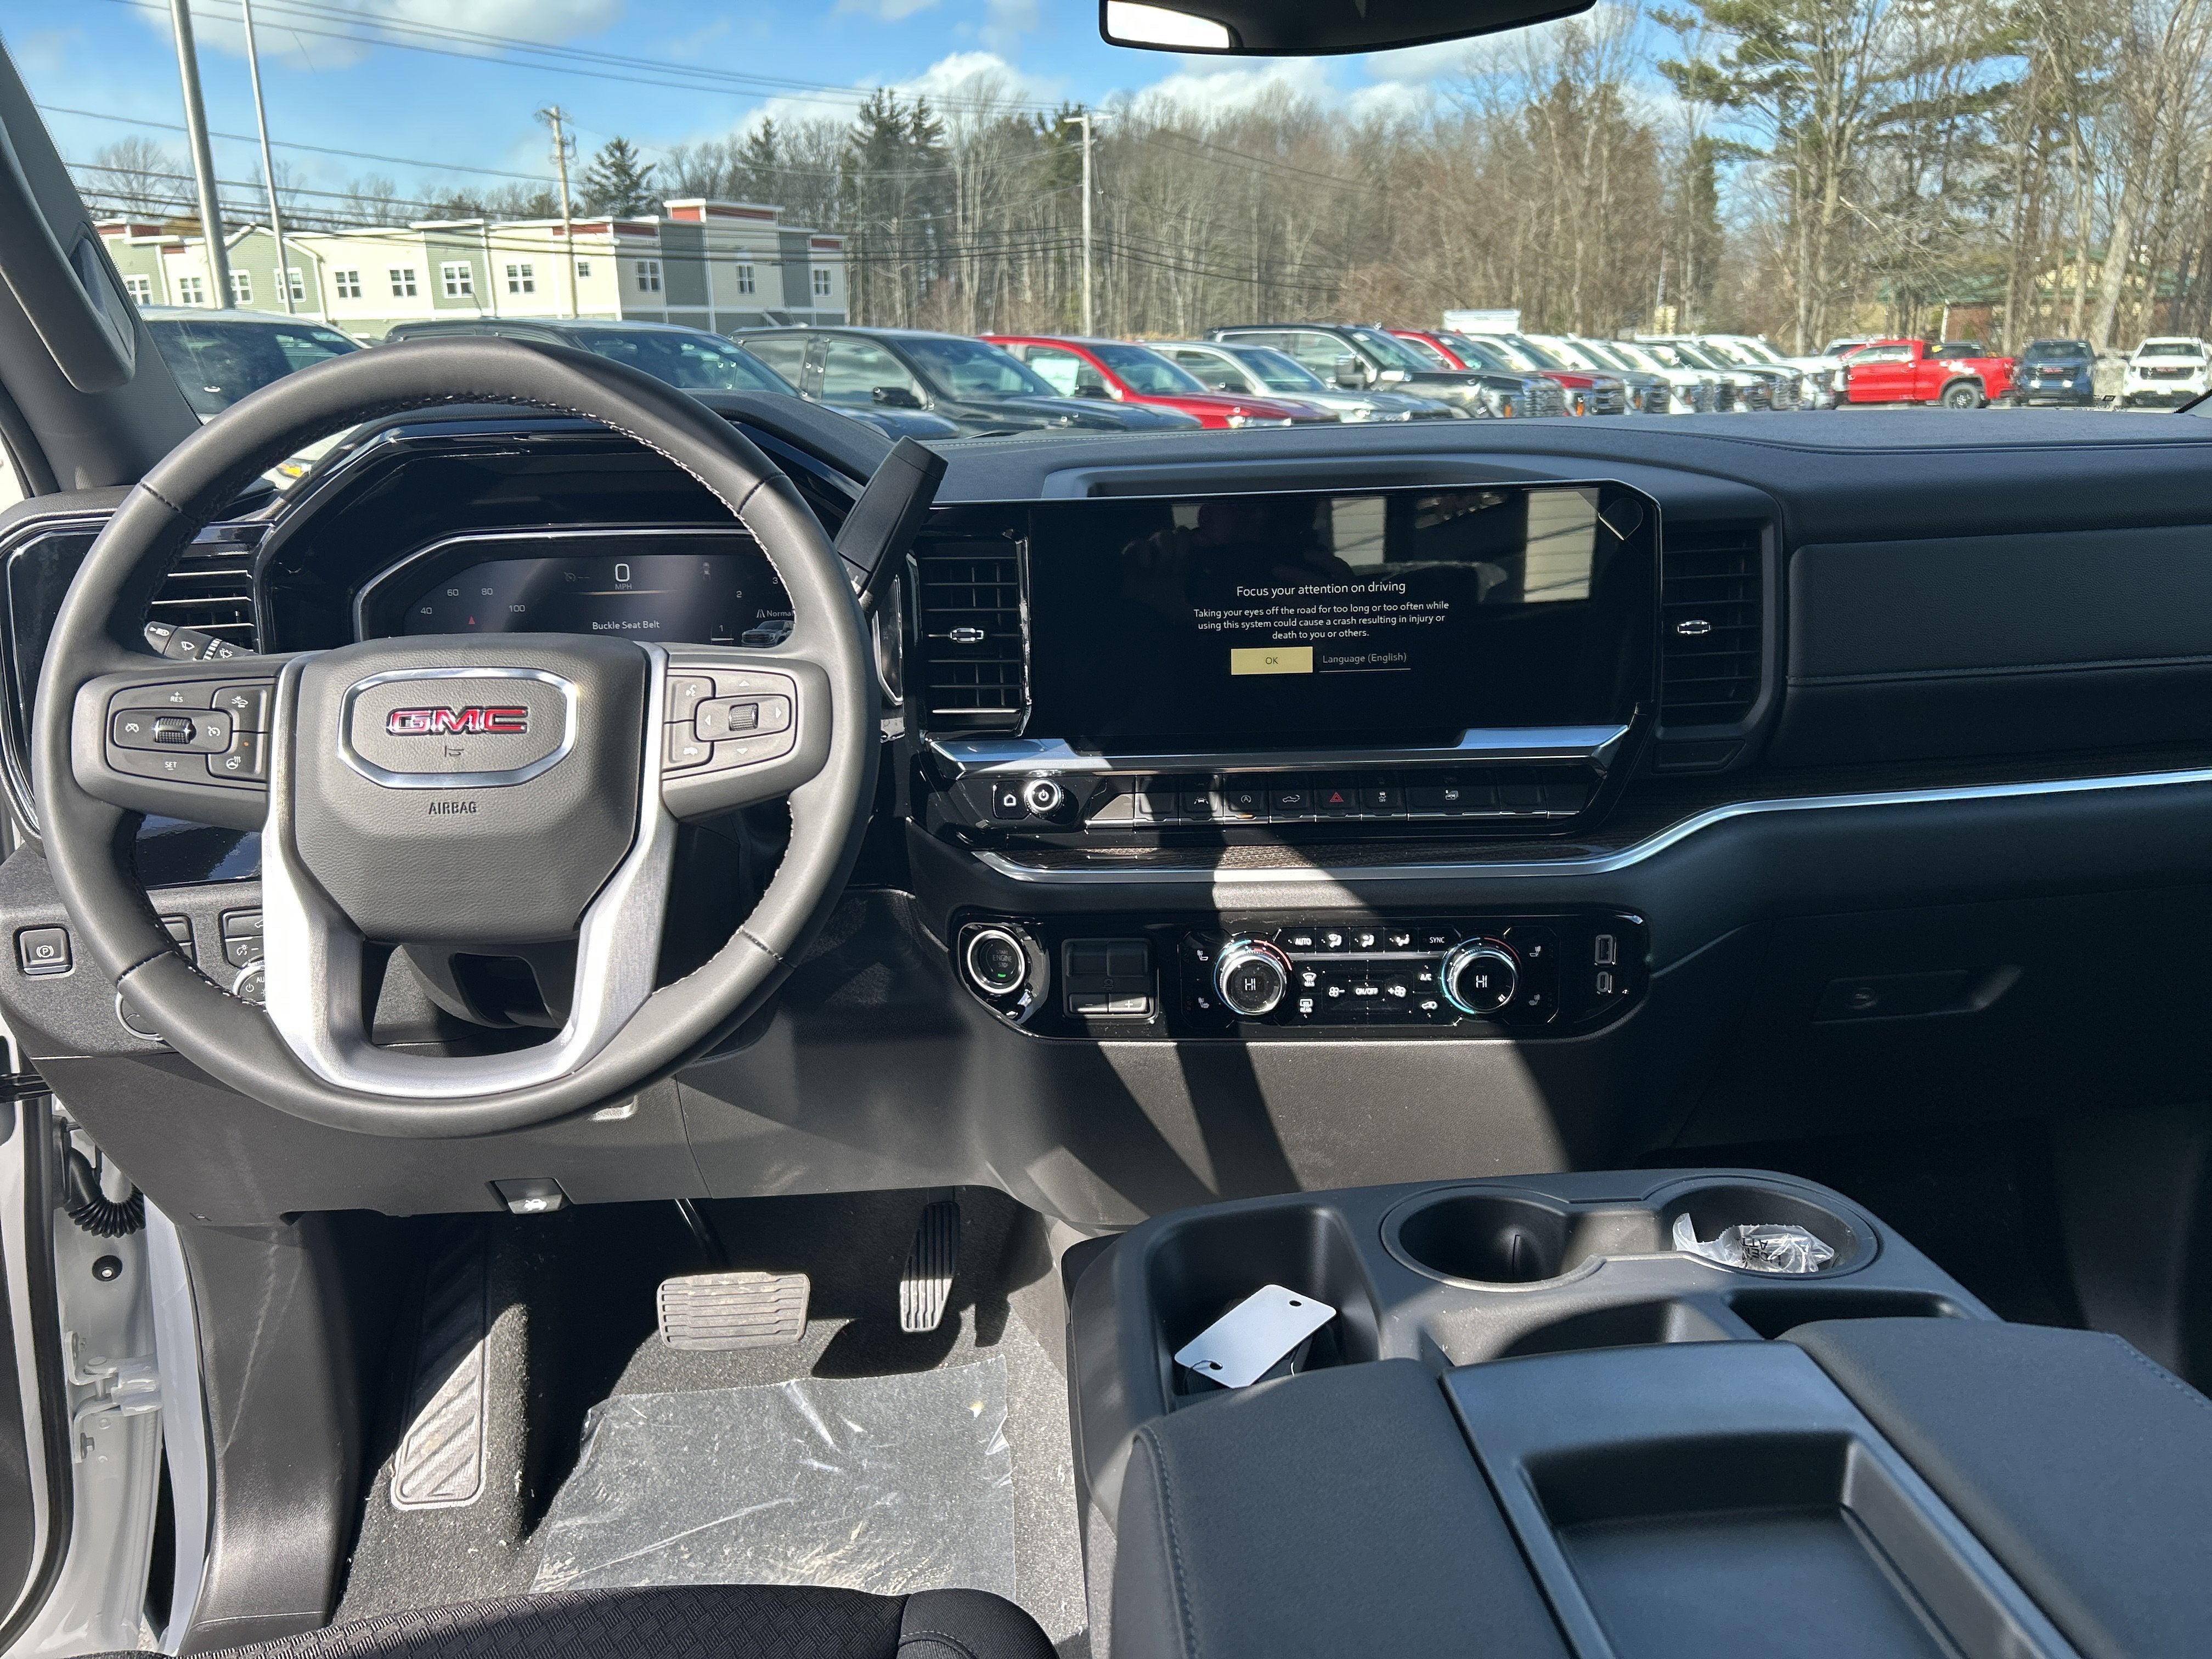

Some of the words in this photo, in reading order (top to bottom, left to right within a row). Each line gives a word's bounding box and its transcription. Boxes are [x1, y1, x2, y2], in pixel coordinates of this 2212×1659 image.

[614, 563, 630, 582] 0
[1237, 586, 1269, 597] Focus
[1271, 587, 1296, 599] your
[1297, 583, 1348, 595] attention
[1351, 584, 1365, 593] on
[1368, 581, 1406, 594] driving
[1193, 608, 1222, 619] Taking
[1223, 610, 1243, 619] your
[1244, 609, 1264, 618] eyes
[1266, 606, 1279, 615] off
[1280, 606, 1295, 614] the
[1297, 605, 1317, 614] road
[1318, 605, 1331, 613] for
[1350, 603, 1370, 614] long
[1400, 601, 1424, 611] often
[1426, 600, 1449, 610] while
[592, 621, 620, 630] Buckle
[622, 621, 641, 629] Seat
[642, 620, 660, 629] Belt
[1198, 621, 1221, 631] using
[1223, 620, 1239, 629] this
[1241, 620, 1272, 630] system
[1273, 618, 1297, 627] could
[1333, 616, 1357, 625] crash
[1358, 615, 1397, 626] resulting
[1398, 614, 1407, 623] in
[1409, 614, 1434, 625] injury
[1272, 630, 1297, 640] death
[1310, 631, 1325, 641] you
[1338, 628, 1370, 637] others.
[1265, 656, 1279, 665] OK
[1323, 655, 1365, 665] Language
[1368, 652, 1407, 664] (English)
[387, 706, 528, 736] GMC
[428, 802, 478, 815] AIRBAG
[1295, 938, 1312, 946] AUTO
[1420, 973, 1432, 981] A/C
[1476, 975, 1488, 988] HI
[1244, 978, 1256, 991] HI
[1355, 987, 1379, 995] ON/OFF
